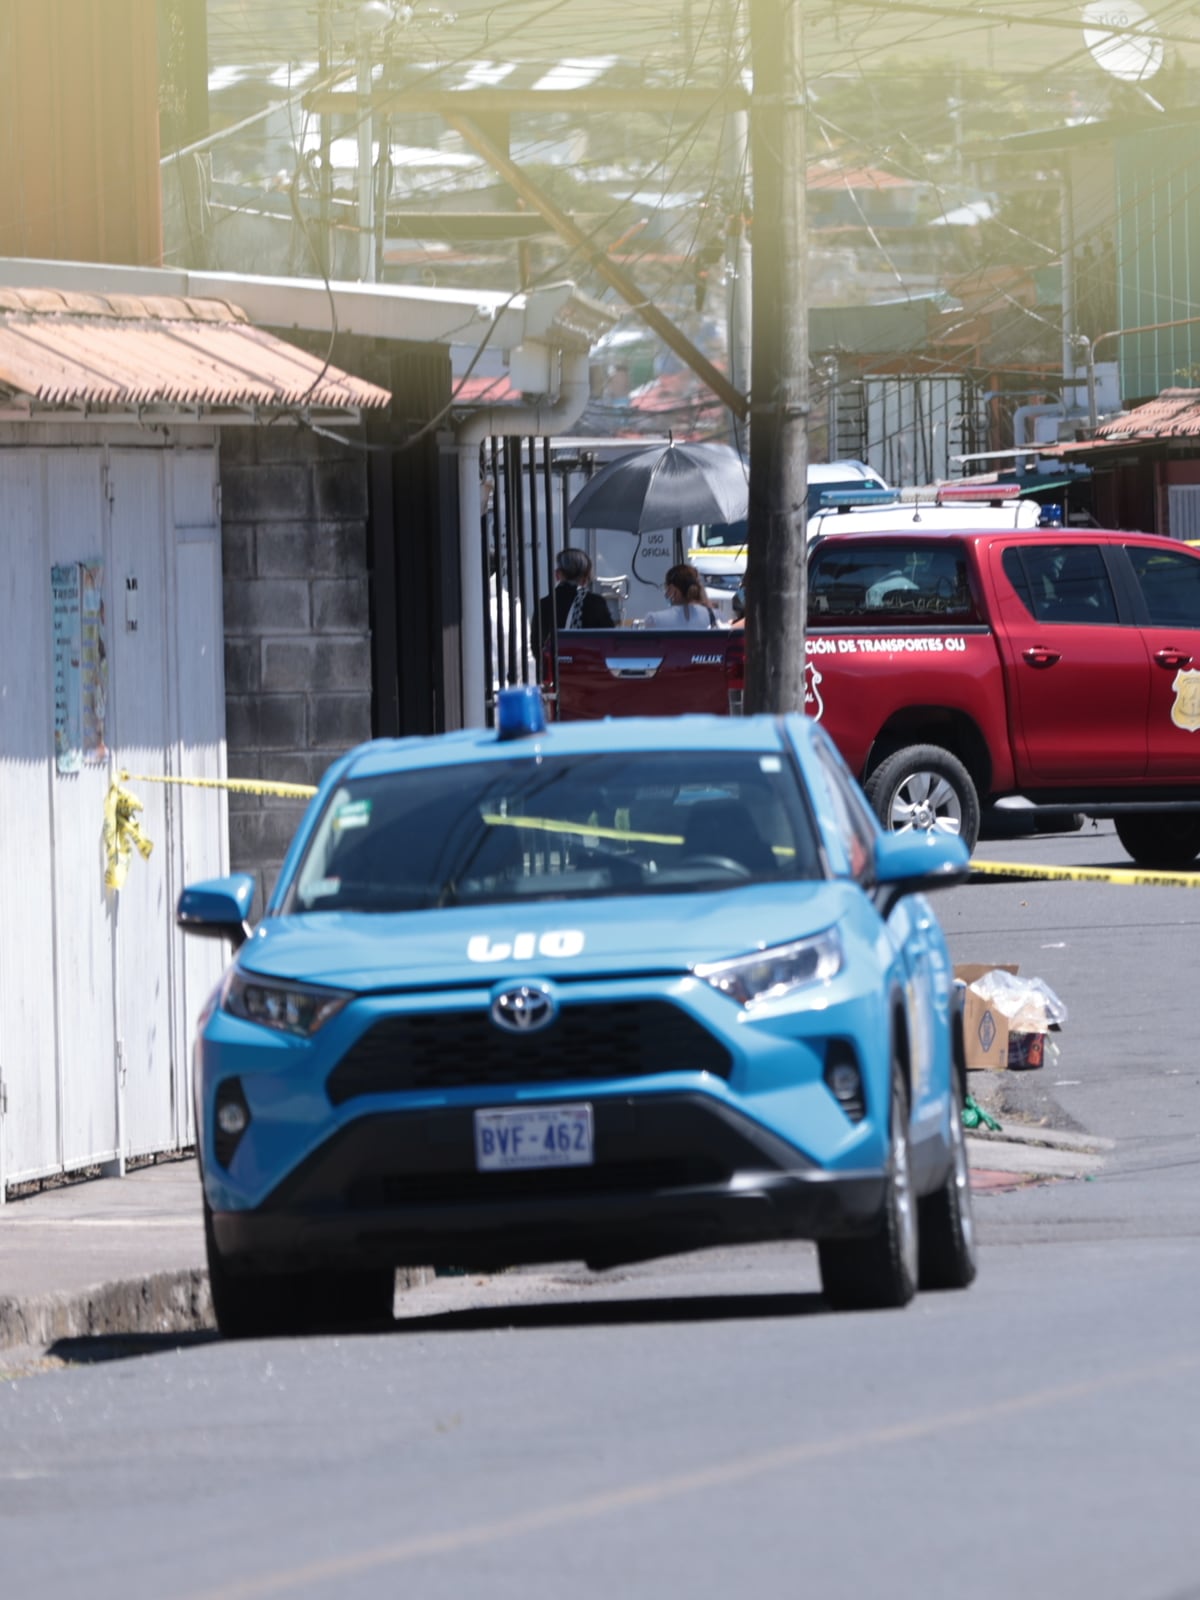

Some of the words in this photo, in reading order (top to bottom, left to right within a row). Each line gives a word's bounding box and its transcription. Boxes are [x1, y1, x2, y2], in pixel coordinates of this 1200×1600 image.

[647, 534, 664, 545] USO
[641, 547, 671, 558] OFICIAL
[804, 638, 836, 655] CIÓN
[838, 639, 857, 653] DE
[857, 637, 944, 653] TRANSPORTES
[944, 637, 967, 652] OIJ
[691, 654, 723, 664] HILUX
[481, 1122, 587, 1156] BVF-462
